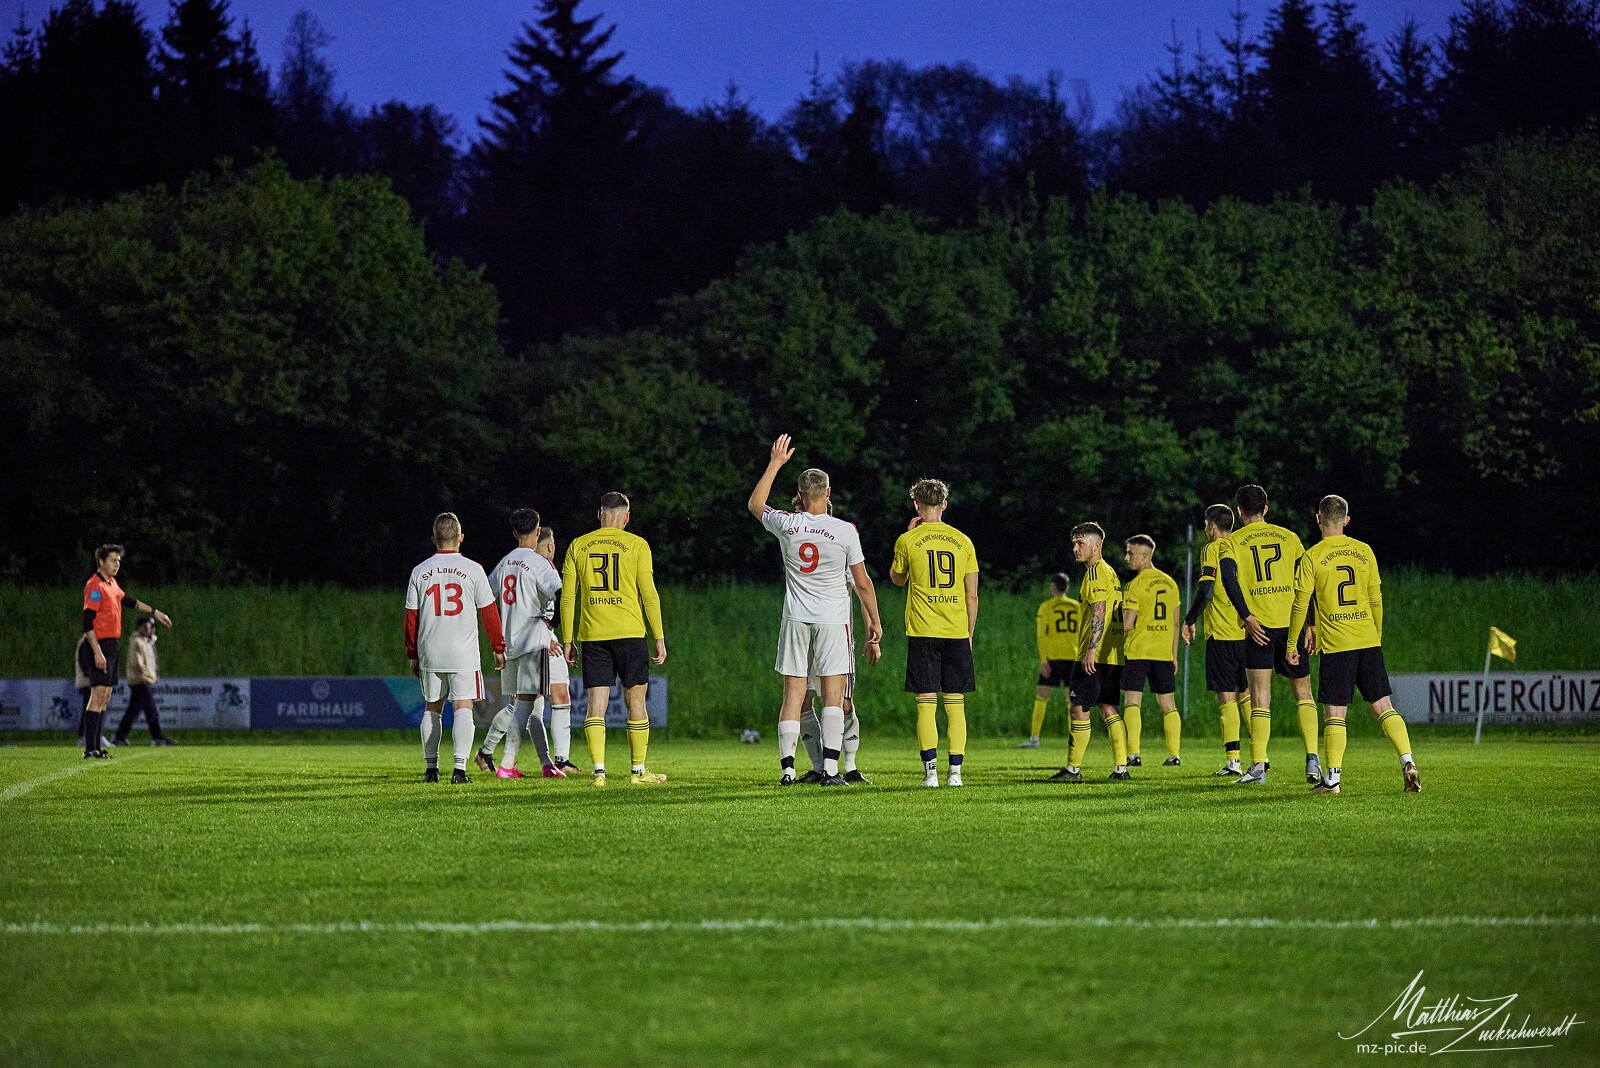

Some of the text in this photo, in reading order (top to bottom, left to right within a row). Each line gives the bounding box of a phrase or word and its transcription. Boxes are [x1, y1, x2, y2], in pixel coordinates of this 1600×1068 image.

[787, 526, 835, 541] SV Laufen
[587, 538, 630, 553] KIRCHANSCHÖRING
[922, 534, 963, 550] KIRCHANSCHÖRING
[507, 559, 530, 572] Laufen
[798, 542, 820, 573] 9
[1249, 543, 1282, 582] 17
[1320, 558, 1329, 566] SV
[421, 567, 467, 581] SV Laufen
[588, 553, 620, 592] 31
[926, 549, 956, 589] 19
[502, 574, 518, 606] 8
[1249, 585, 1292, 597] WIEDEMANN
[1336, 565, 1358, 606] 2
[425, 583, 464, 617] 13
[589, 596, 623, 606] BIRNER
[927, 593, 958, 604] STÖWE
[1154, 589, 1167, 621] 6
[1053, 610, 1078, 633] 26
[276, 702, 365, 717] FARBHAUS
